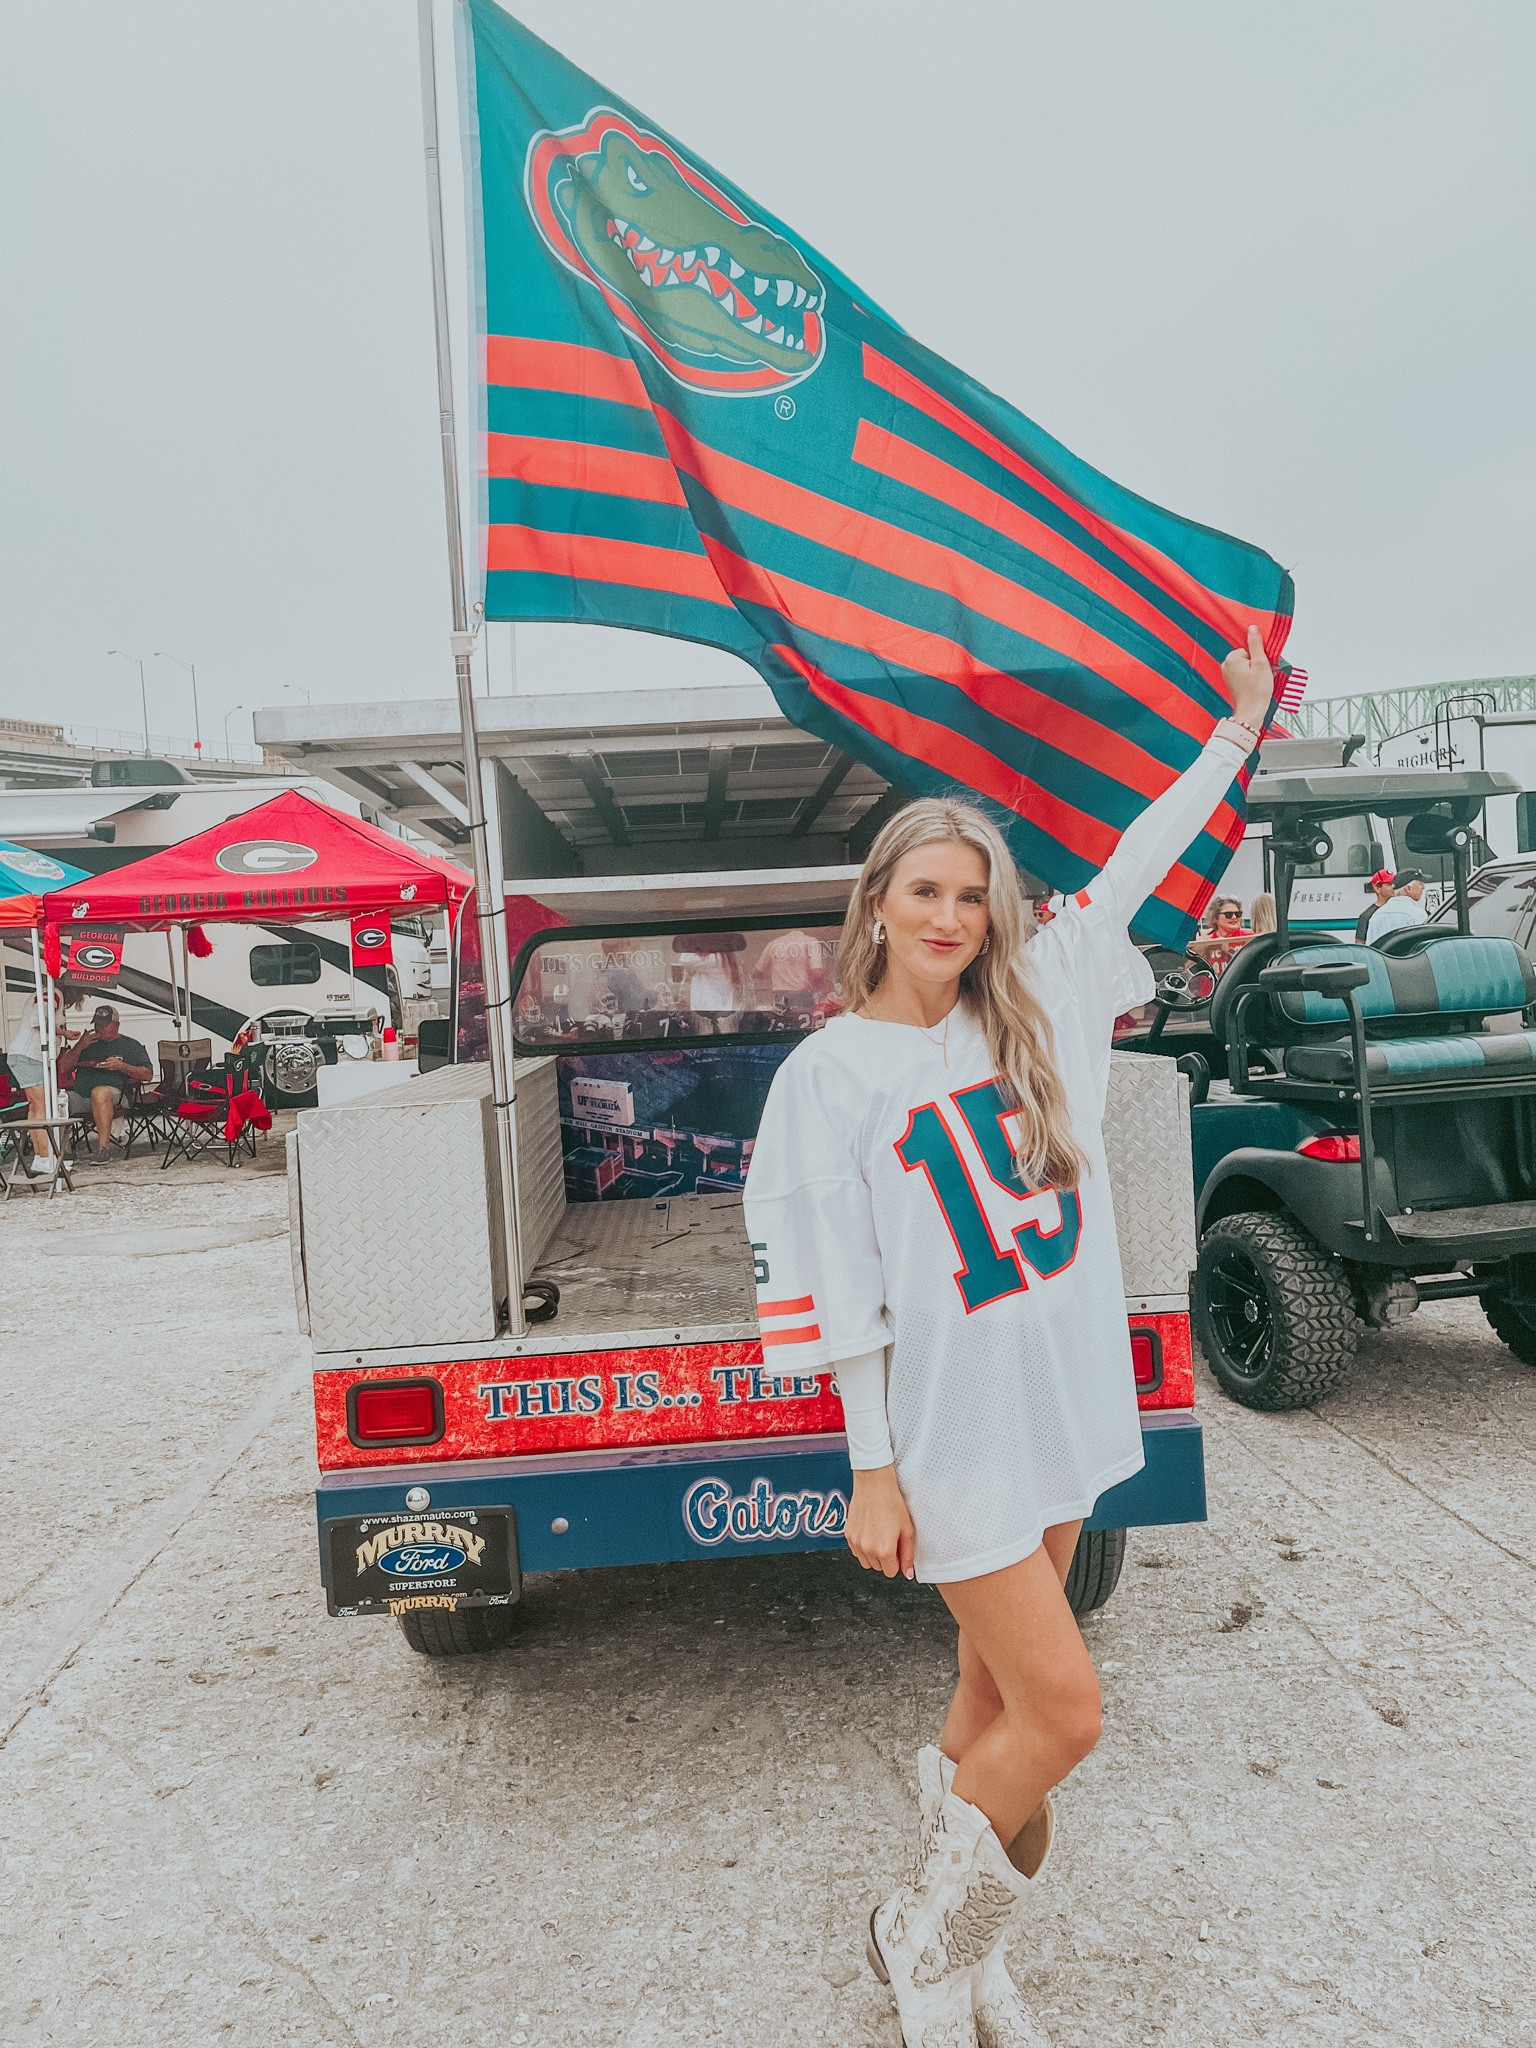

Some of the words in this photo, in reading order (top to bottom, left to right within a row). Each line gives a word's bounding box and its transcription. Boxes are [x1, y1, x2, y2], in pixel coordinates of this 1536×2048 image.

[139, 892, 227, 914] GEORGIA
[243, 885, 347, 909] BULLDOGS
[80, 931, 118, 940] GEORGIA
[587, 950, 665, 972] GATOR
[773, 940, 842, 959] COUN
[71, 972, 110, 982] BULLDOGS
[893, 1075, 1083, 1315] 15
[479, 1376, 602, 1422] THIS
[613, 1371, 702, 1412] IS...
[711, 1365, 820, 1404] THE
[363, 1510, 475, 1526] www.shazamauto.com
[685, 1478, 848, 1544] Gators
[356, 1522, 487, 1577] MURRAY
[395, 1548, 450, 1573] Ford
[389, 1578, 457, 1591] SUPERSTORE
[338, 1607, 358, 1617] Ford
[390, 1595, 458, 1617] MURRAY
[488, 1596, 509, 1605] Ford
